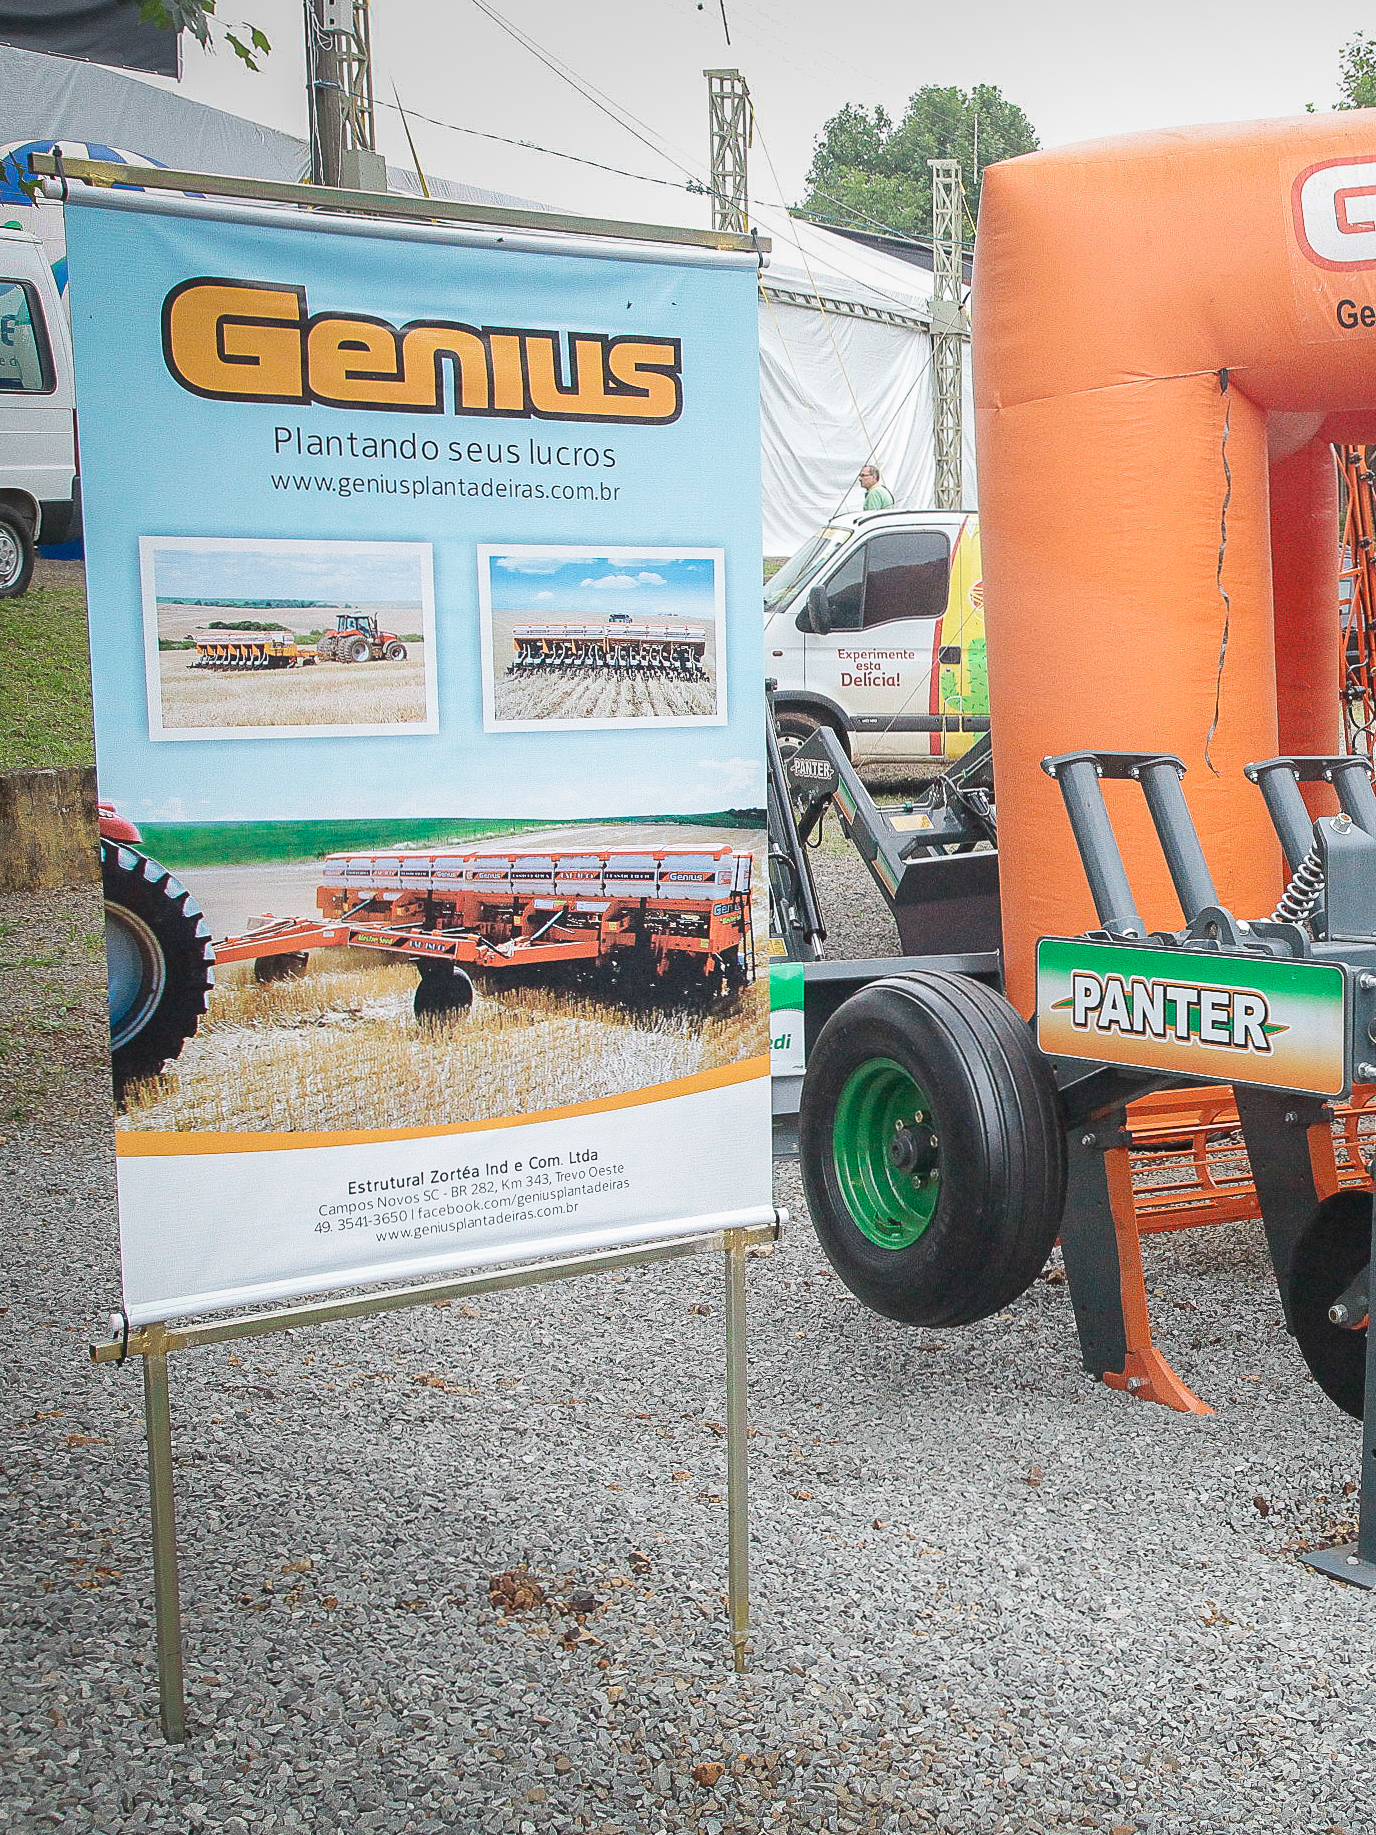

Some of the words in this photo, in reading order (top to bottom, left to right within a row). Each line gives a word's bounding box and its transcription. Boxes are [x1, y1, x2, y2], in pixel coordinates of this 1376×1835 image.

[161, 276, 684, 425] Genius
[274, 426, 439, 460] Plantando
[448, 441, 521, 464] seus
[530, 438, 616, 467] lucros
[270, 473, 621, 501] www.geniusplantadeiras.com.br
[837, 648, 915, 662] Experimente
[856, 661, 881, 671] esta
[841, 671, 901, 687] Delícia!
[793, 757, 831, 780] PANTER
[669, 872, 703, 881] Genius
[1071, 968, 1274, 1057] PANTER
[318, 1200, 374, 1217] Campos
[377, 1193, 420, 1208] Novos
[423, 1188, 440, 1202] SC
[451, 1185, 468, 1198] BR
[471, 1181, 498, 1196] 282,
[501, 1178, 522, 1191] Km
[526, 1173, 552, 1188] 343,
[555, 1169, 586, 1183] Trevo
[588, 1163, 624, 1178] Oeste
[348, 1171, 424, 1195] Estrutural
[430, 1165, 480, 1184] Zortéa
[486, 1160, 508, 1176] Ind
[514, 1161, 523, 1172] e
[529, 1155, 564, 1170] Com.
[569, 1149, 598, 1164] Ltda
[314, 1221, 333, 1234] 49.
[338, 1209, 408, 1232] 3541-3650
[418, 1178, 630, 1219] facebook.com/geniusplantadeiras
[375, 1202, 578, 1242] www.geniusplantadeiras.com.br
